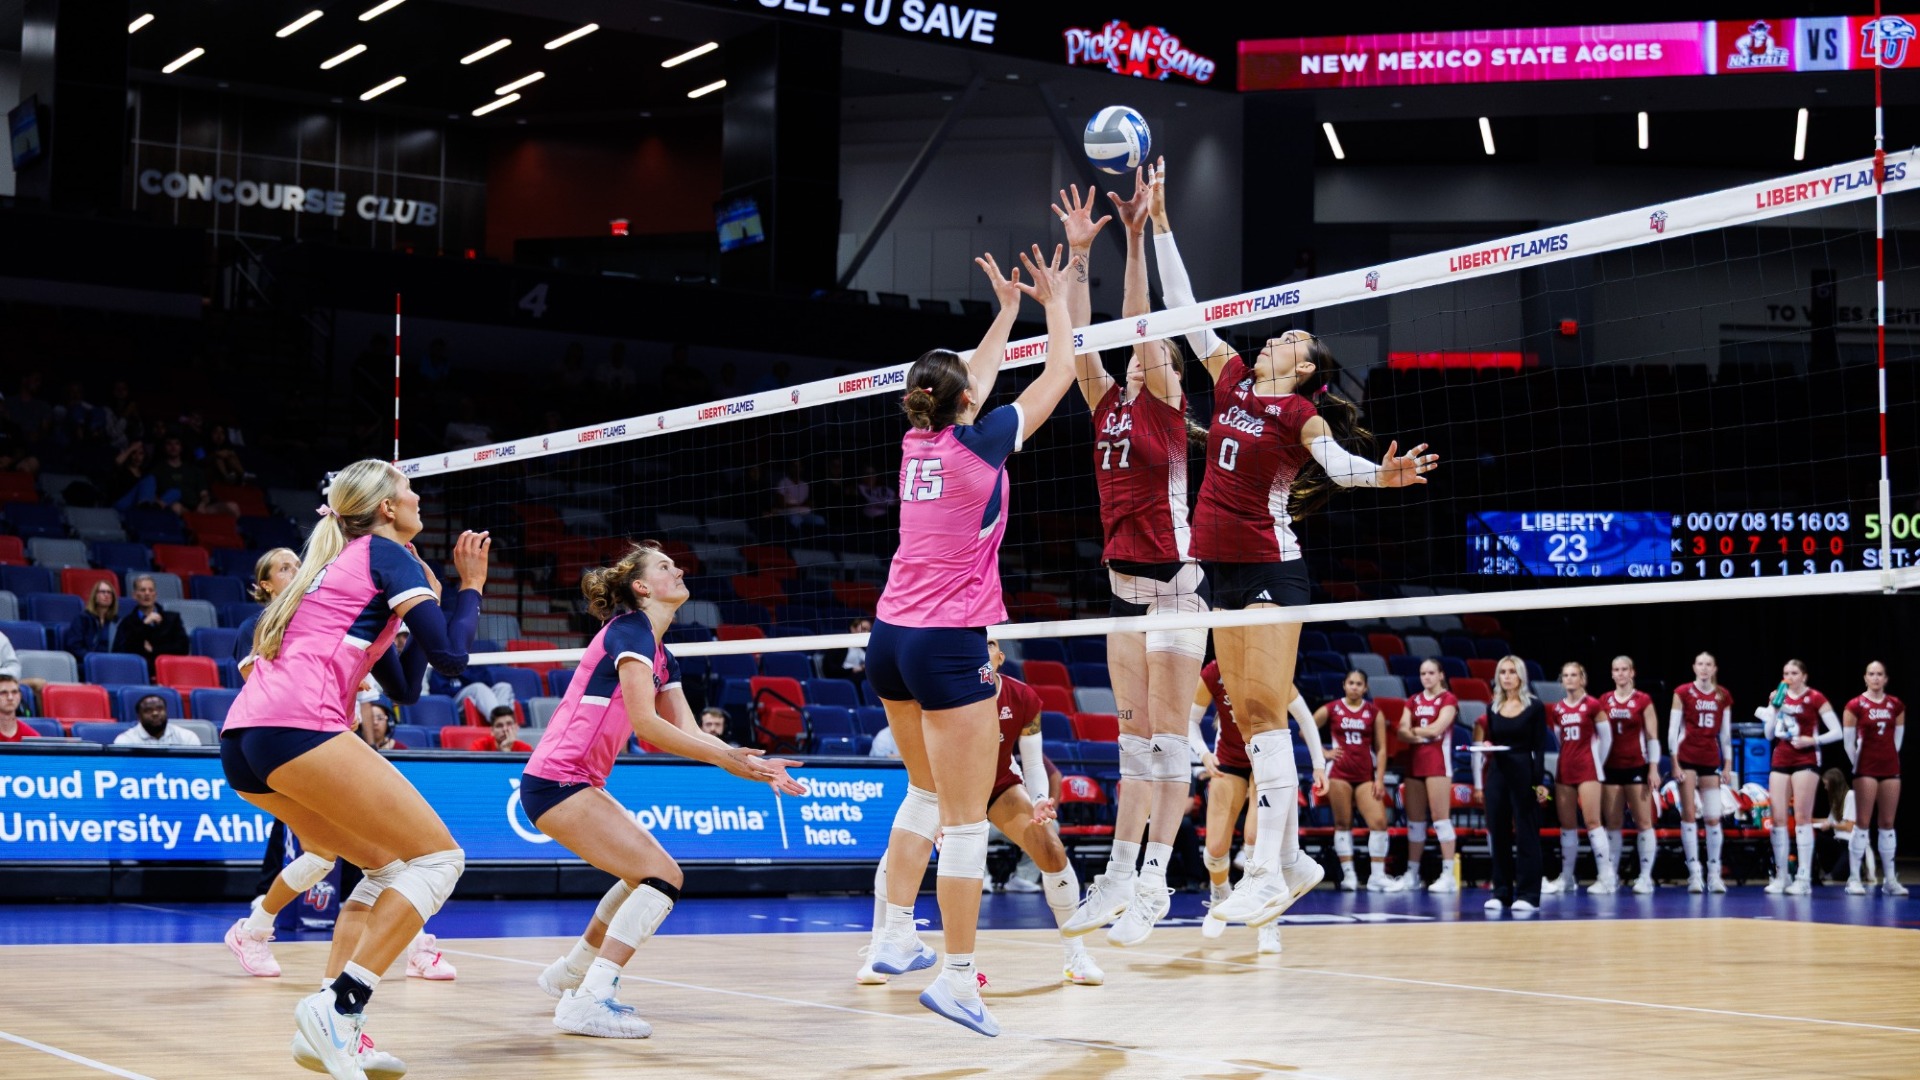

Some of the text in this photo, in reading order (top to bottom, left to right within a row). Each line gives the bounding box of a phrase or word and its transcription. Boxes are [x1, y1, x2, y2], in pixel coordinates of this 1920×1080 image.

[899, 0, 998, 44] SAVE
[1064, 23, 1216, 82] Pick-N-Save
[1300, 43, 1663, 75] NEW MEXICO STATE AGGIES
[1807, 28, 1838, 61] VS
[139, 169, 438, 226] CONCOURSE CLUB
[1756, 162, 1907, 209] LIBERTYFLAES
[1448, 233, 1569, 273] LIBERTYFLAMES
[517, 282, 550, 319] 4
[1204, 289, 1300, 322] LIBERTYFLAMES
[1767, 305, 1795, 321] TO
[1802, 306, 1863, 323] VES
[838, 370, 905, 394] LIBERTYFLAMES
[698, 400, 754, 421] LIBERTYFLAMES
[578, 424, 626, 443] LIBERTYFLAMES
[1097, 438, 1131, 470] 77
[1218, 437, 1240, 472] 0
[902, 457, 944, 502] 15
[1521, 512, 1614, 532] LIBERTY
[1687, 512, 1712, 531] 00
[1714, 512, 1739, 531] 07
[1741, 512, 1767, 531] 08
[1770, 512, 1794, 531] 15
[1798, 512, 1822, 531] 16
[1823, 512, 1850, 531] 03
[1547, 533, 1589, 563] 23
[1671, 535, 1844, 555] K 3 0 7 1 0 0
[1671, 561, 1684, 575] D
[1696, 559, 1707, 577] 1
[1720, 559, 1735, 577] 0
[1750, 559, 1761, 577] 1
[1778, 559, 1789, 577] 1
[1563, 725, 1580, 741] 30
[1697, 713, 1716, 728] 16
[1876, 721, 1886, 735] 7
[0, 770, 227, 799] roud Partner
[797, 777, 884, 802] Stronger
[627, 805, 765, 835] oVirginia
[800, 801, 863, 822] starts
[0, 812, 182, 850] University
[804, 824, 857, 845] here.
